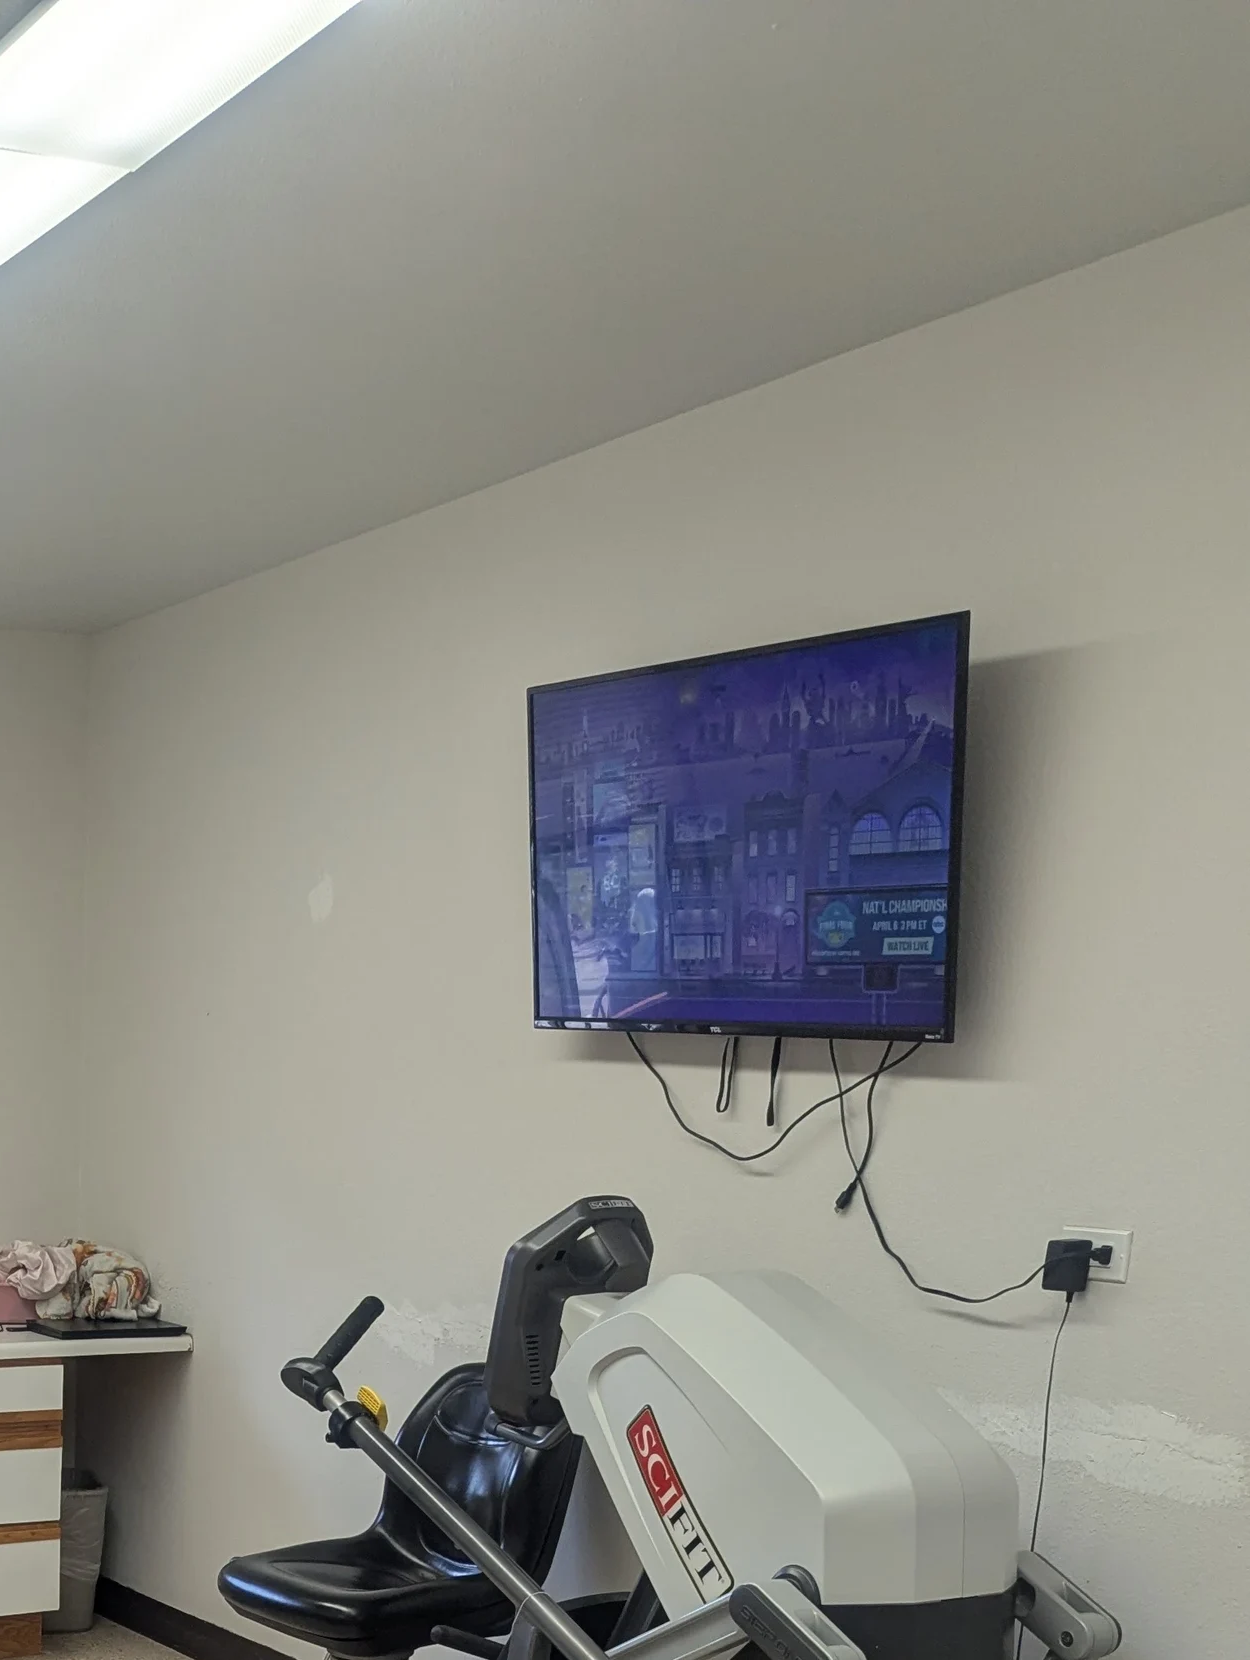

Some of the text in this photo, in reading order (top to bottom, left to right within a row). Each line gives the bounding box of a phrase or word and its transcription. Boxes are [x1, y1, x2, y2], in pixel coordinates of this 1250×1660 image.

[862, 901, 888, 914] NAT'L
[872, 921, 892, 931] APRIL
[906, 920, 917, 931] PM
[918, 920, 928, 930] ET
[887, 940, 929, 951] WATCH LIVE
[634, 1424, 723, 1586] SCIFIT
